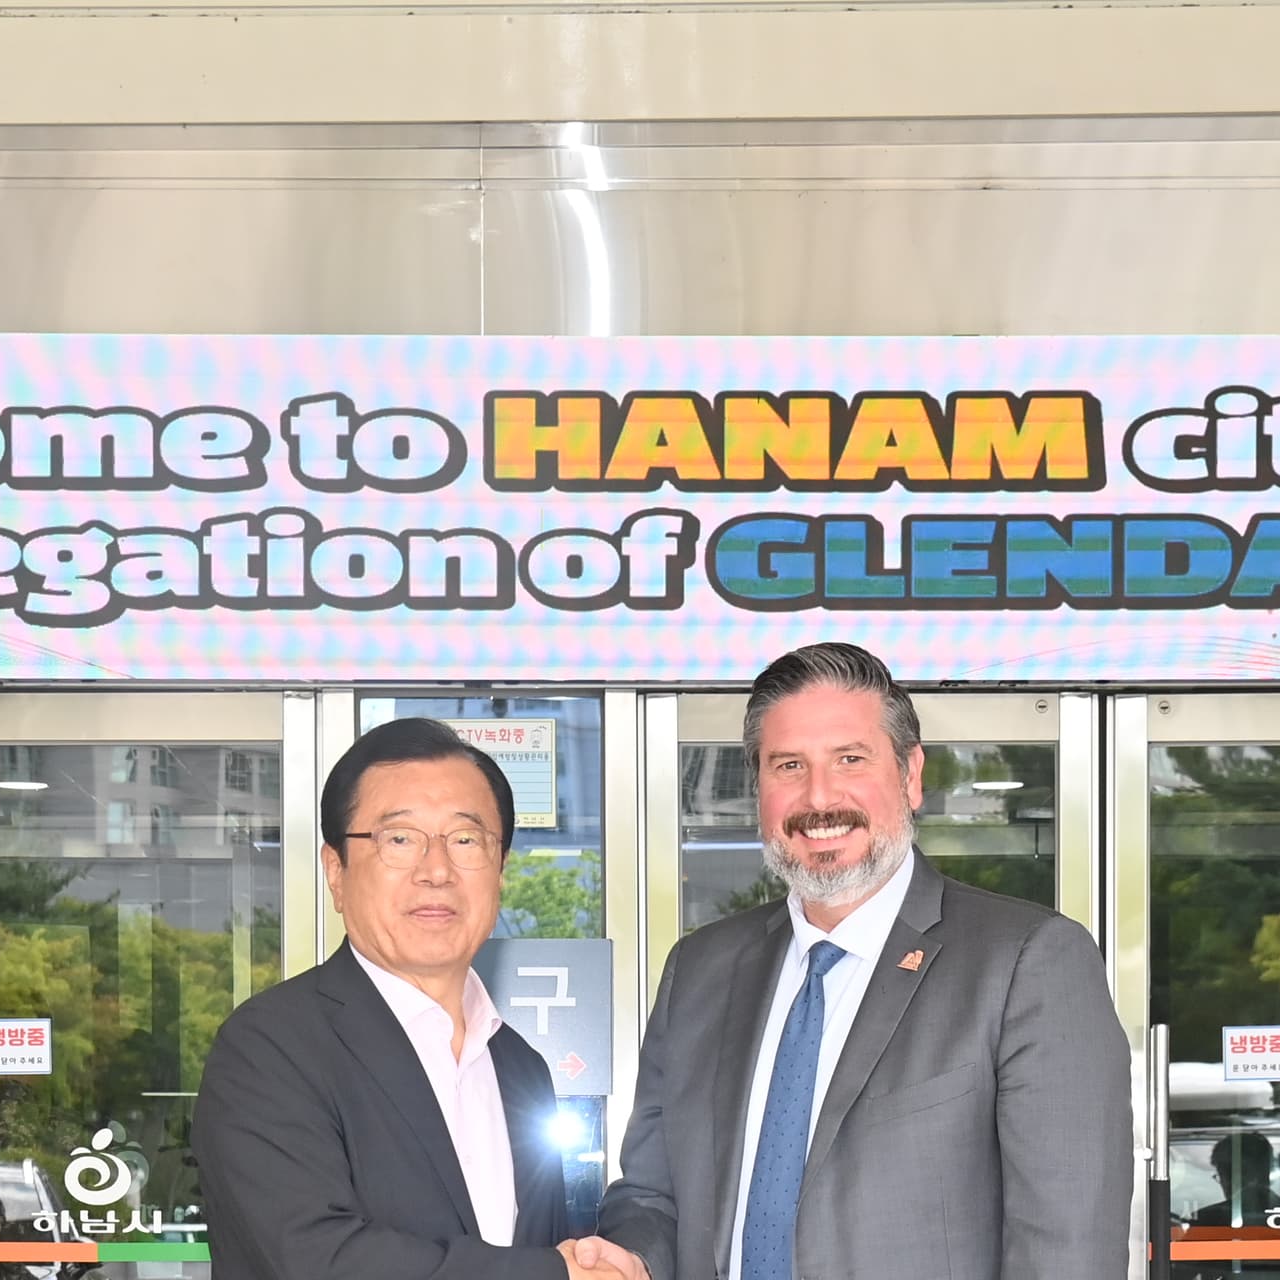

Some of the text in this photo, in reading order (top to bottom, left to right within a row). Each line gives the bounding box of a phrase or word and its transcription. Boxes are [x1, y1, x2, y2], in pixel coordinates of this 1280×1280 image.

[280, 391, 467, 492] to
[483, 390, 1107, 492] HANAM
[518, 507, 700, 610] of
[20, 1056, 43, 1065] 주세요
[31, 1210, 162, 1235] 하남시
